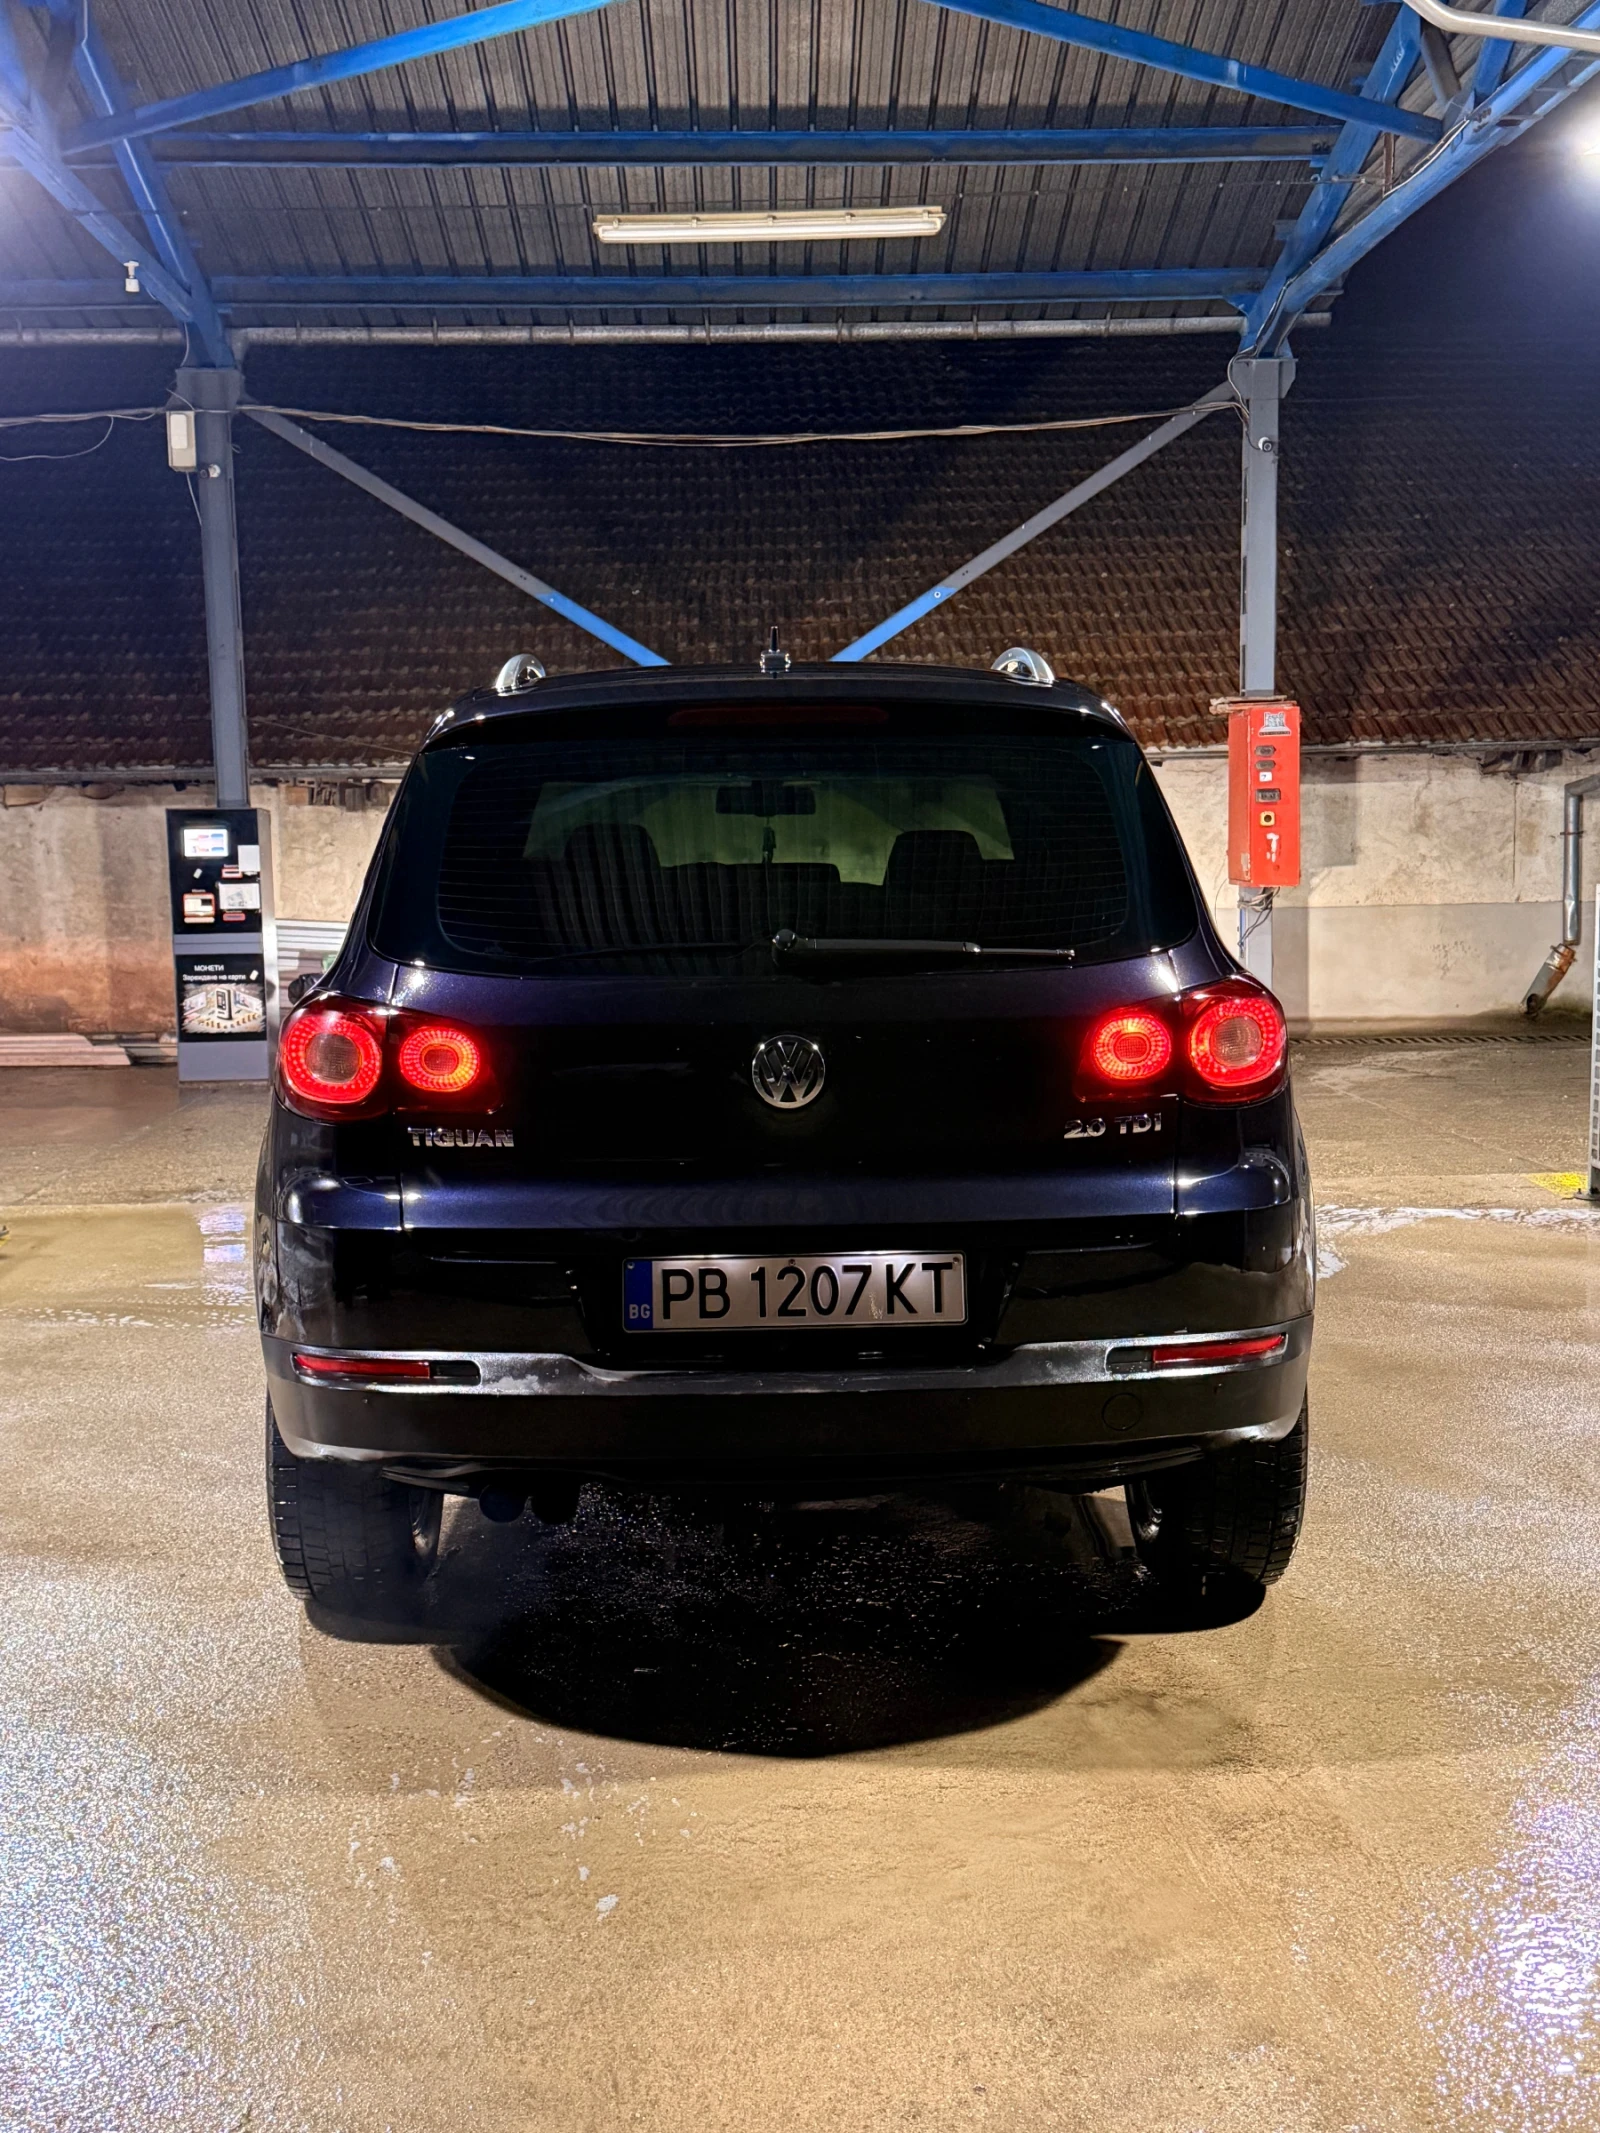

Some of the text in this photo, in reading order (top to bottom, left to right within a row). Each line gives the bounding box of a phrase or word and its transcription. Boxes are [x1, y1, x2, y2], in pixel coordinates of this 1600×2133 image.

[754, 1037, 823, 1106] VW
[1113, 1112, 1162, 1135] TDI
[407, 1126, 515, 1148] TIGUAN
[661, 1262, 954, 1320] PB 1207 KT
[628, 1304, 651, 1320] BG
